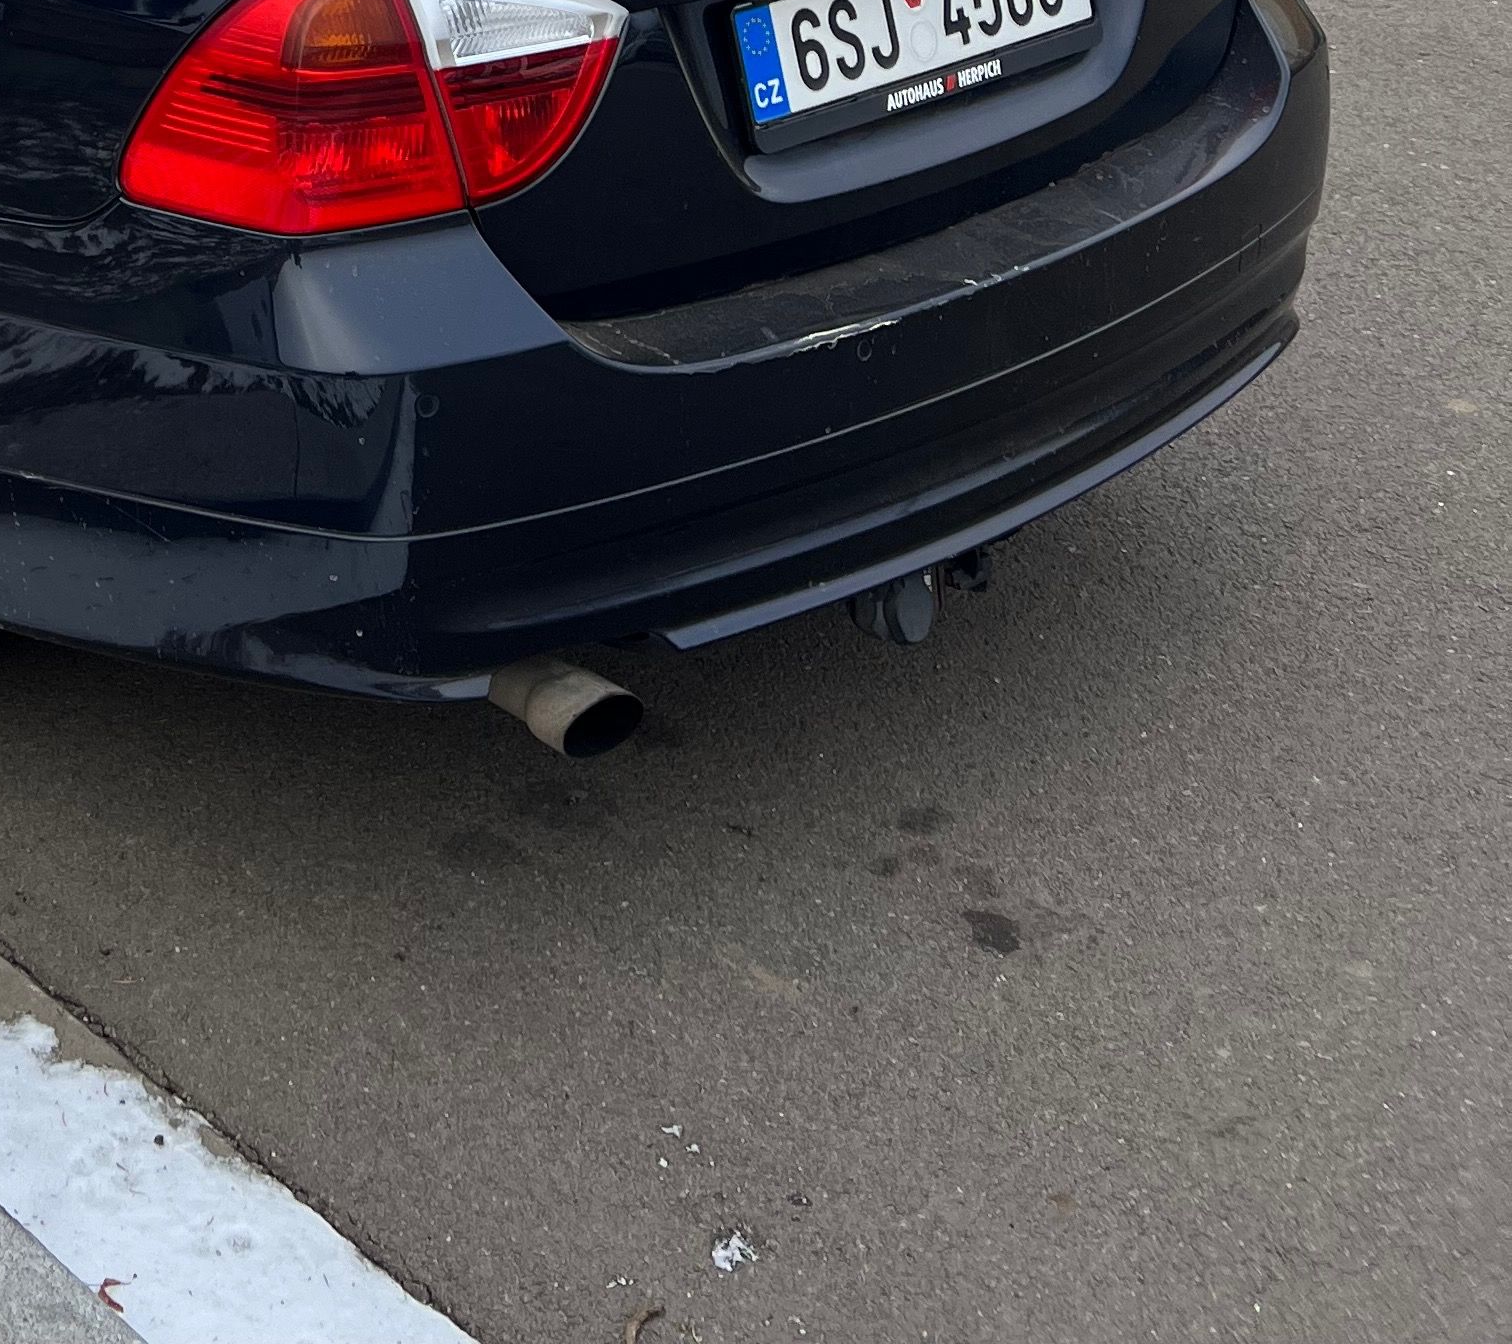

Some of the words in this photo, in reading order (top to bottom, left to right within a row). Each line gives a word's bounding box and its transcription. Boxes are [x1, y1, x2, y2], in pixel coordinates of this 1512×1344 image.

[754, 79, 784, 108] CZ
[886, 77, 945, 112] AUTOHAUS
[957, 58, 1002, 88] HERPICH
